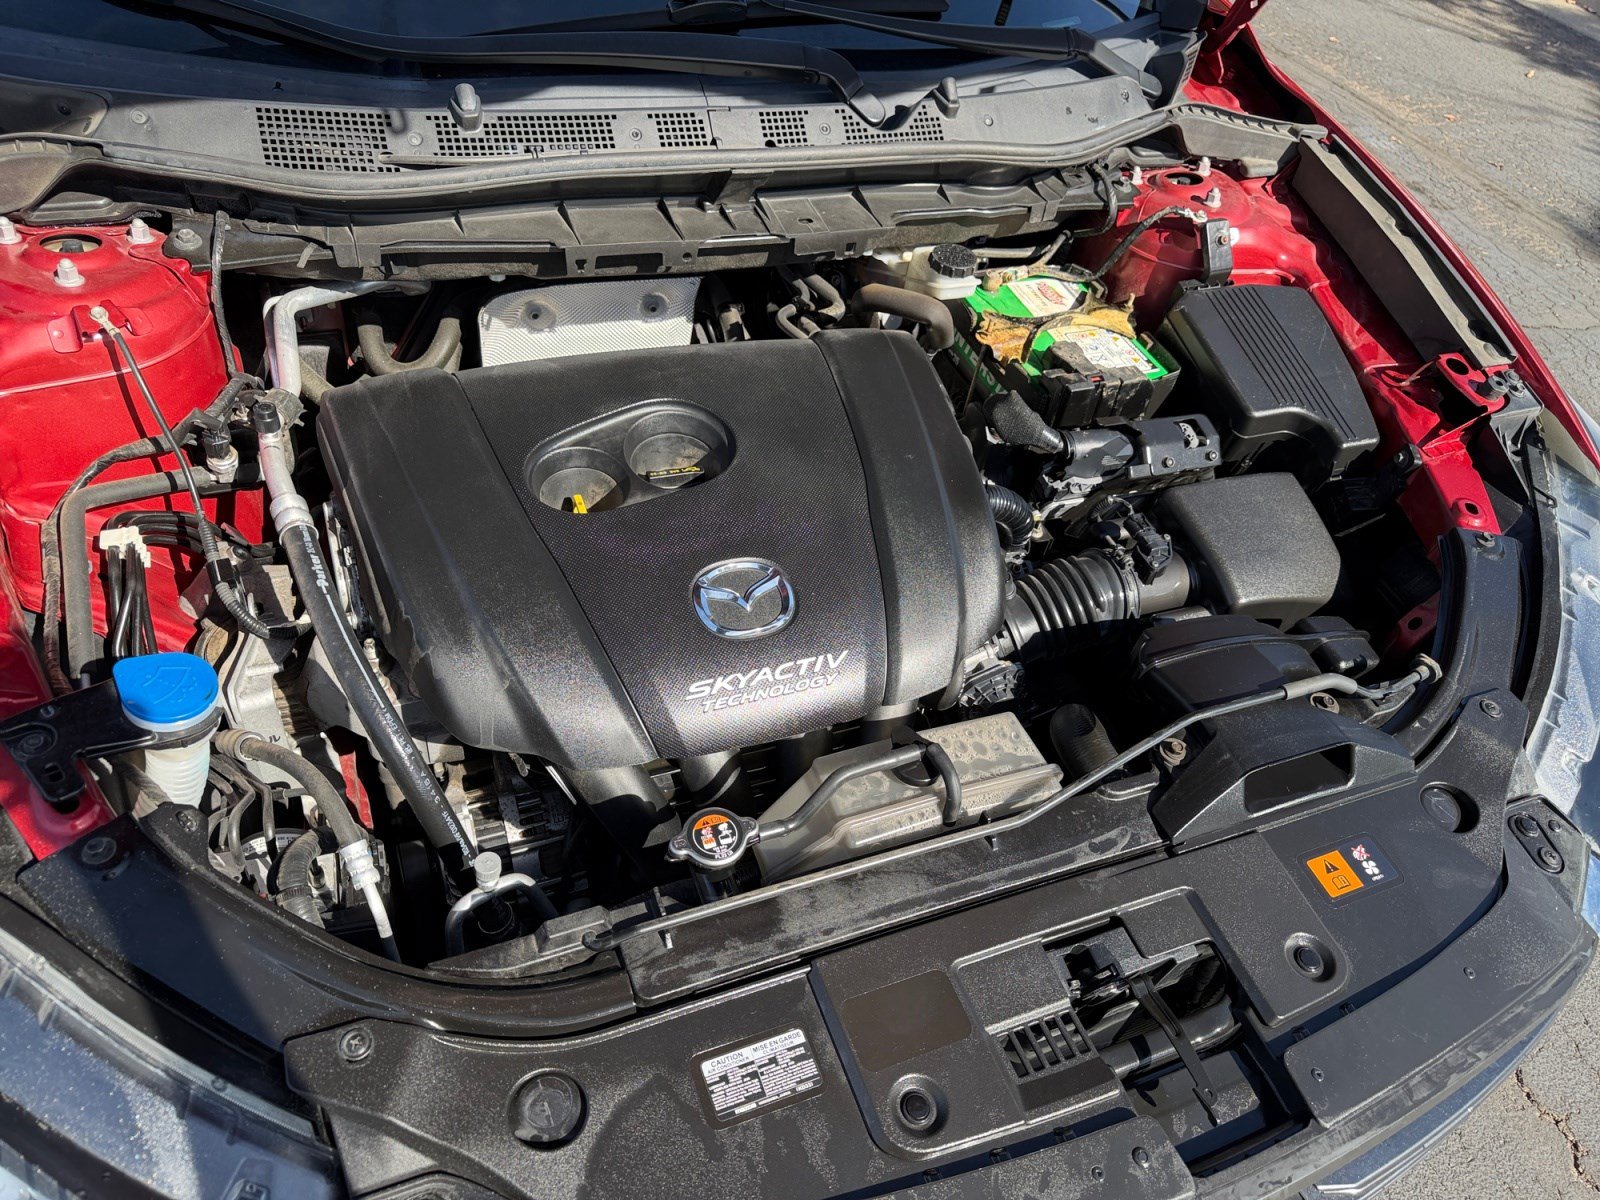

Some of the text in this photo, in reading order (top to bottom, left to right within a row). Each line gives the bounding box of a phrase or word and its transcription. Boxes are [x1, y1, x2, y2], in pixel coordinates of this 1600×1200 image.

[311, 554, 329, 588] Parker
[686, 650, 848, 701] SKYACTIV
[702, 672, 841, 713] TECHNOLOGY
[752, 1031, 802, 1053] MISE EN GARDE
[710, 1051, 744, 1068] CAUTION
